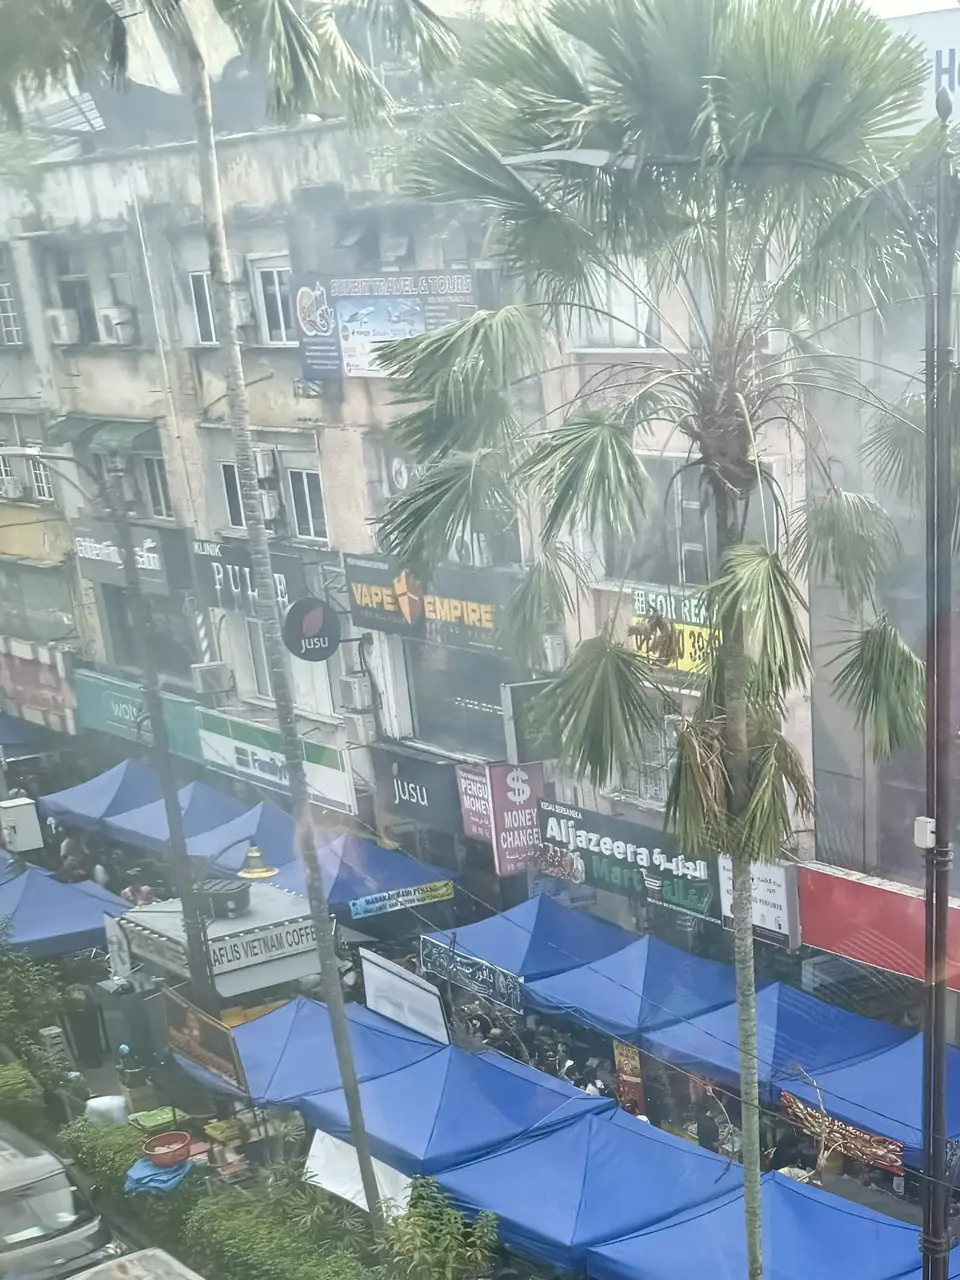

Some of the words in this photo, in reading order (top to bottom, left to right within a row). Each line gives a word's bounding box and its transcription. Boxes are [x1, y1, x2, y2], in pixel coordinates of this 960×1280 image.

[428, 275, 472, 293] TOURS
[193, 541, 222, 557] KLINIK
[211, 562, 288, 600] PULE
[351, 582, 395, 611] VAPE
[423, 595, 494, 629] EMPIRE
[461, 778, 488, 799] PENGU
[504, 808, 538, 828] MONEY
[546, 816, 650, 867] Aljazeera
[591, 855, 644, 892] Mart
[212, 945, 241, 967] AFLIS
[241, 933, 284, 959] VIETNAM
[285, 924, 316, 947] COFFE
